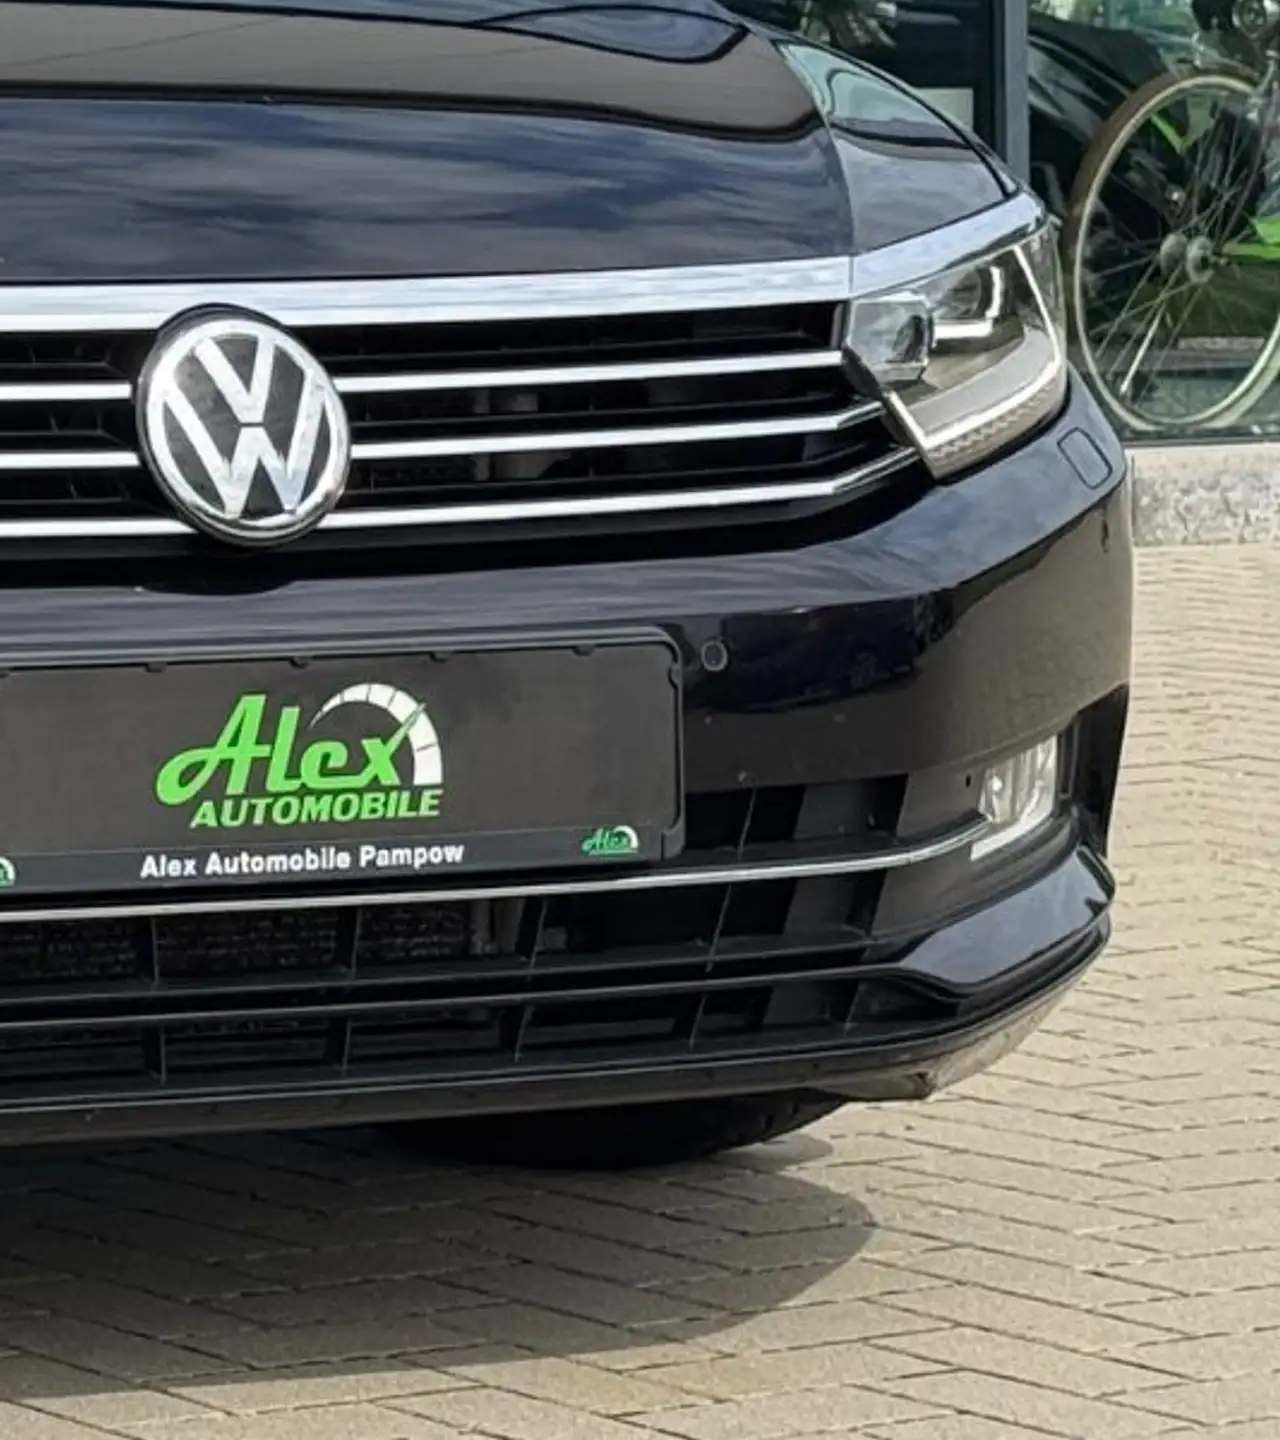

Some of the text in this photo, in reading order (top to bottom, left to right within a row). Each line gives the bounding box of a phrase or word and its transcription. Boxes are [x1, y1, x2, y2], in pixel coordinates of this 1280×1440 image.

[156, 693, 425, 806] Alex
[190, 789, 444, 829] AUTOMOBILE
[139, 844, 466, 878] Alex Automobile Pampow
